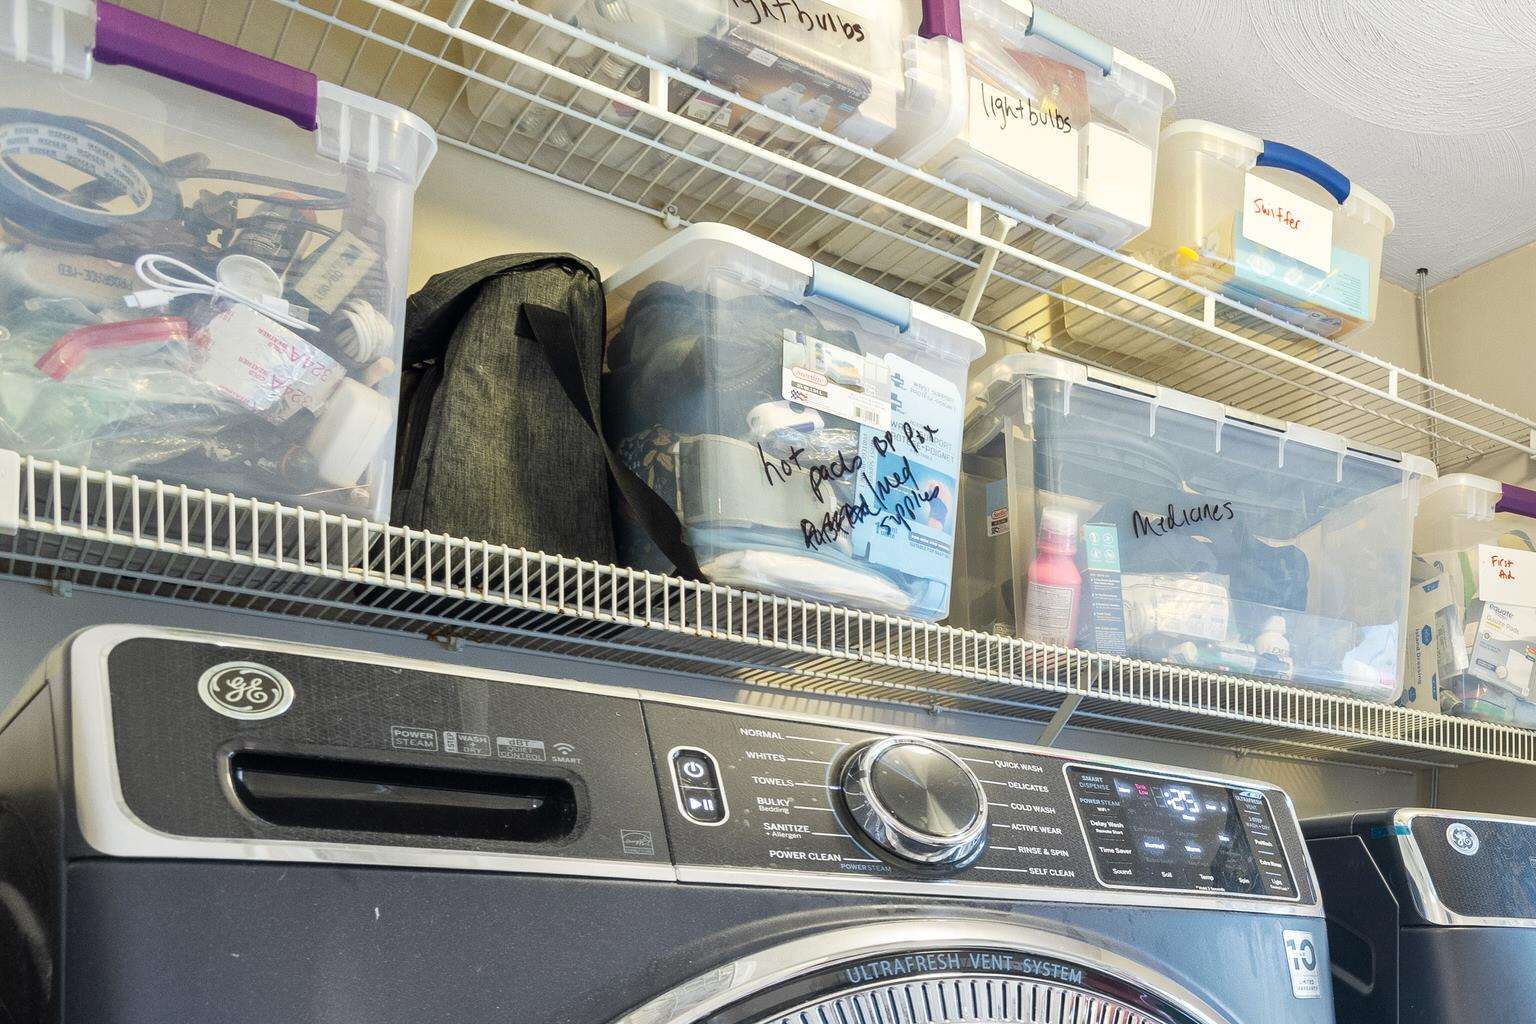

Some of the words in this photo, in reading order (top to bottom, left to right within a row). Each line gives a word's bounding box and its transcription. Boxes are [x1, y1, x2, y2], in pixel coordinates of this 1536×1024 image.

[757, 441, 805, 487] hot
[809, 449, 863, 504] pads
[394, 729, 434, 740] POWER
[458, 734, 487, 744] WASH
[739, 728, 785, 740] NORMAL
[395, 738, 434, 748] STEAM
[551, 756, 583, 764] SMART
[745, 750, 786, 762] WHITES
[995, 760, 1020, 770] QUICK
[1020, 763, 1044, 773] WASH
[751, 776, 795, 787] TOWELS
[1007, 781, 1049, 793] DELICATES
[756, 797, 791, 807] BULKY
[758, 805, 790, 815] Bedding
[1010, 802, 1032, 812] COLD
[1032, 805, 1056, 815] WASH
[763, 822, 811, 833] SANITIZE
[1011, 823, 1039, 833] ACTIVE
[1039, 825, 1063, 835] WEAR
[771, 831, 802, 840] Allergen
[769, 850, 807, 861] POWER
[808, 852, 842, 862] CLEAN
[1018, 845, 1042, 855] RINSE
[1050, 848, 1070, 858] SPIN
[1098, 846, 1115, 854] Time
[1114, 847, 1133, 855] Saver
[1028, 867, 1048, 876] SELF
[1049, 868, 1075, 878] CLEAN
[846, 951, 961, 985] ULTRAFRESH
[969, 952, 1014, 971] VENT
[1022, 957, 1083, 985] SYSTEM
